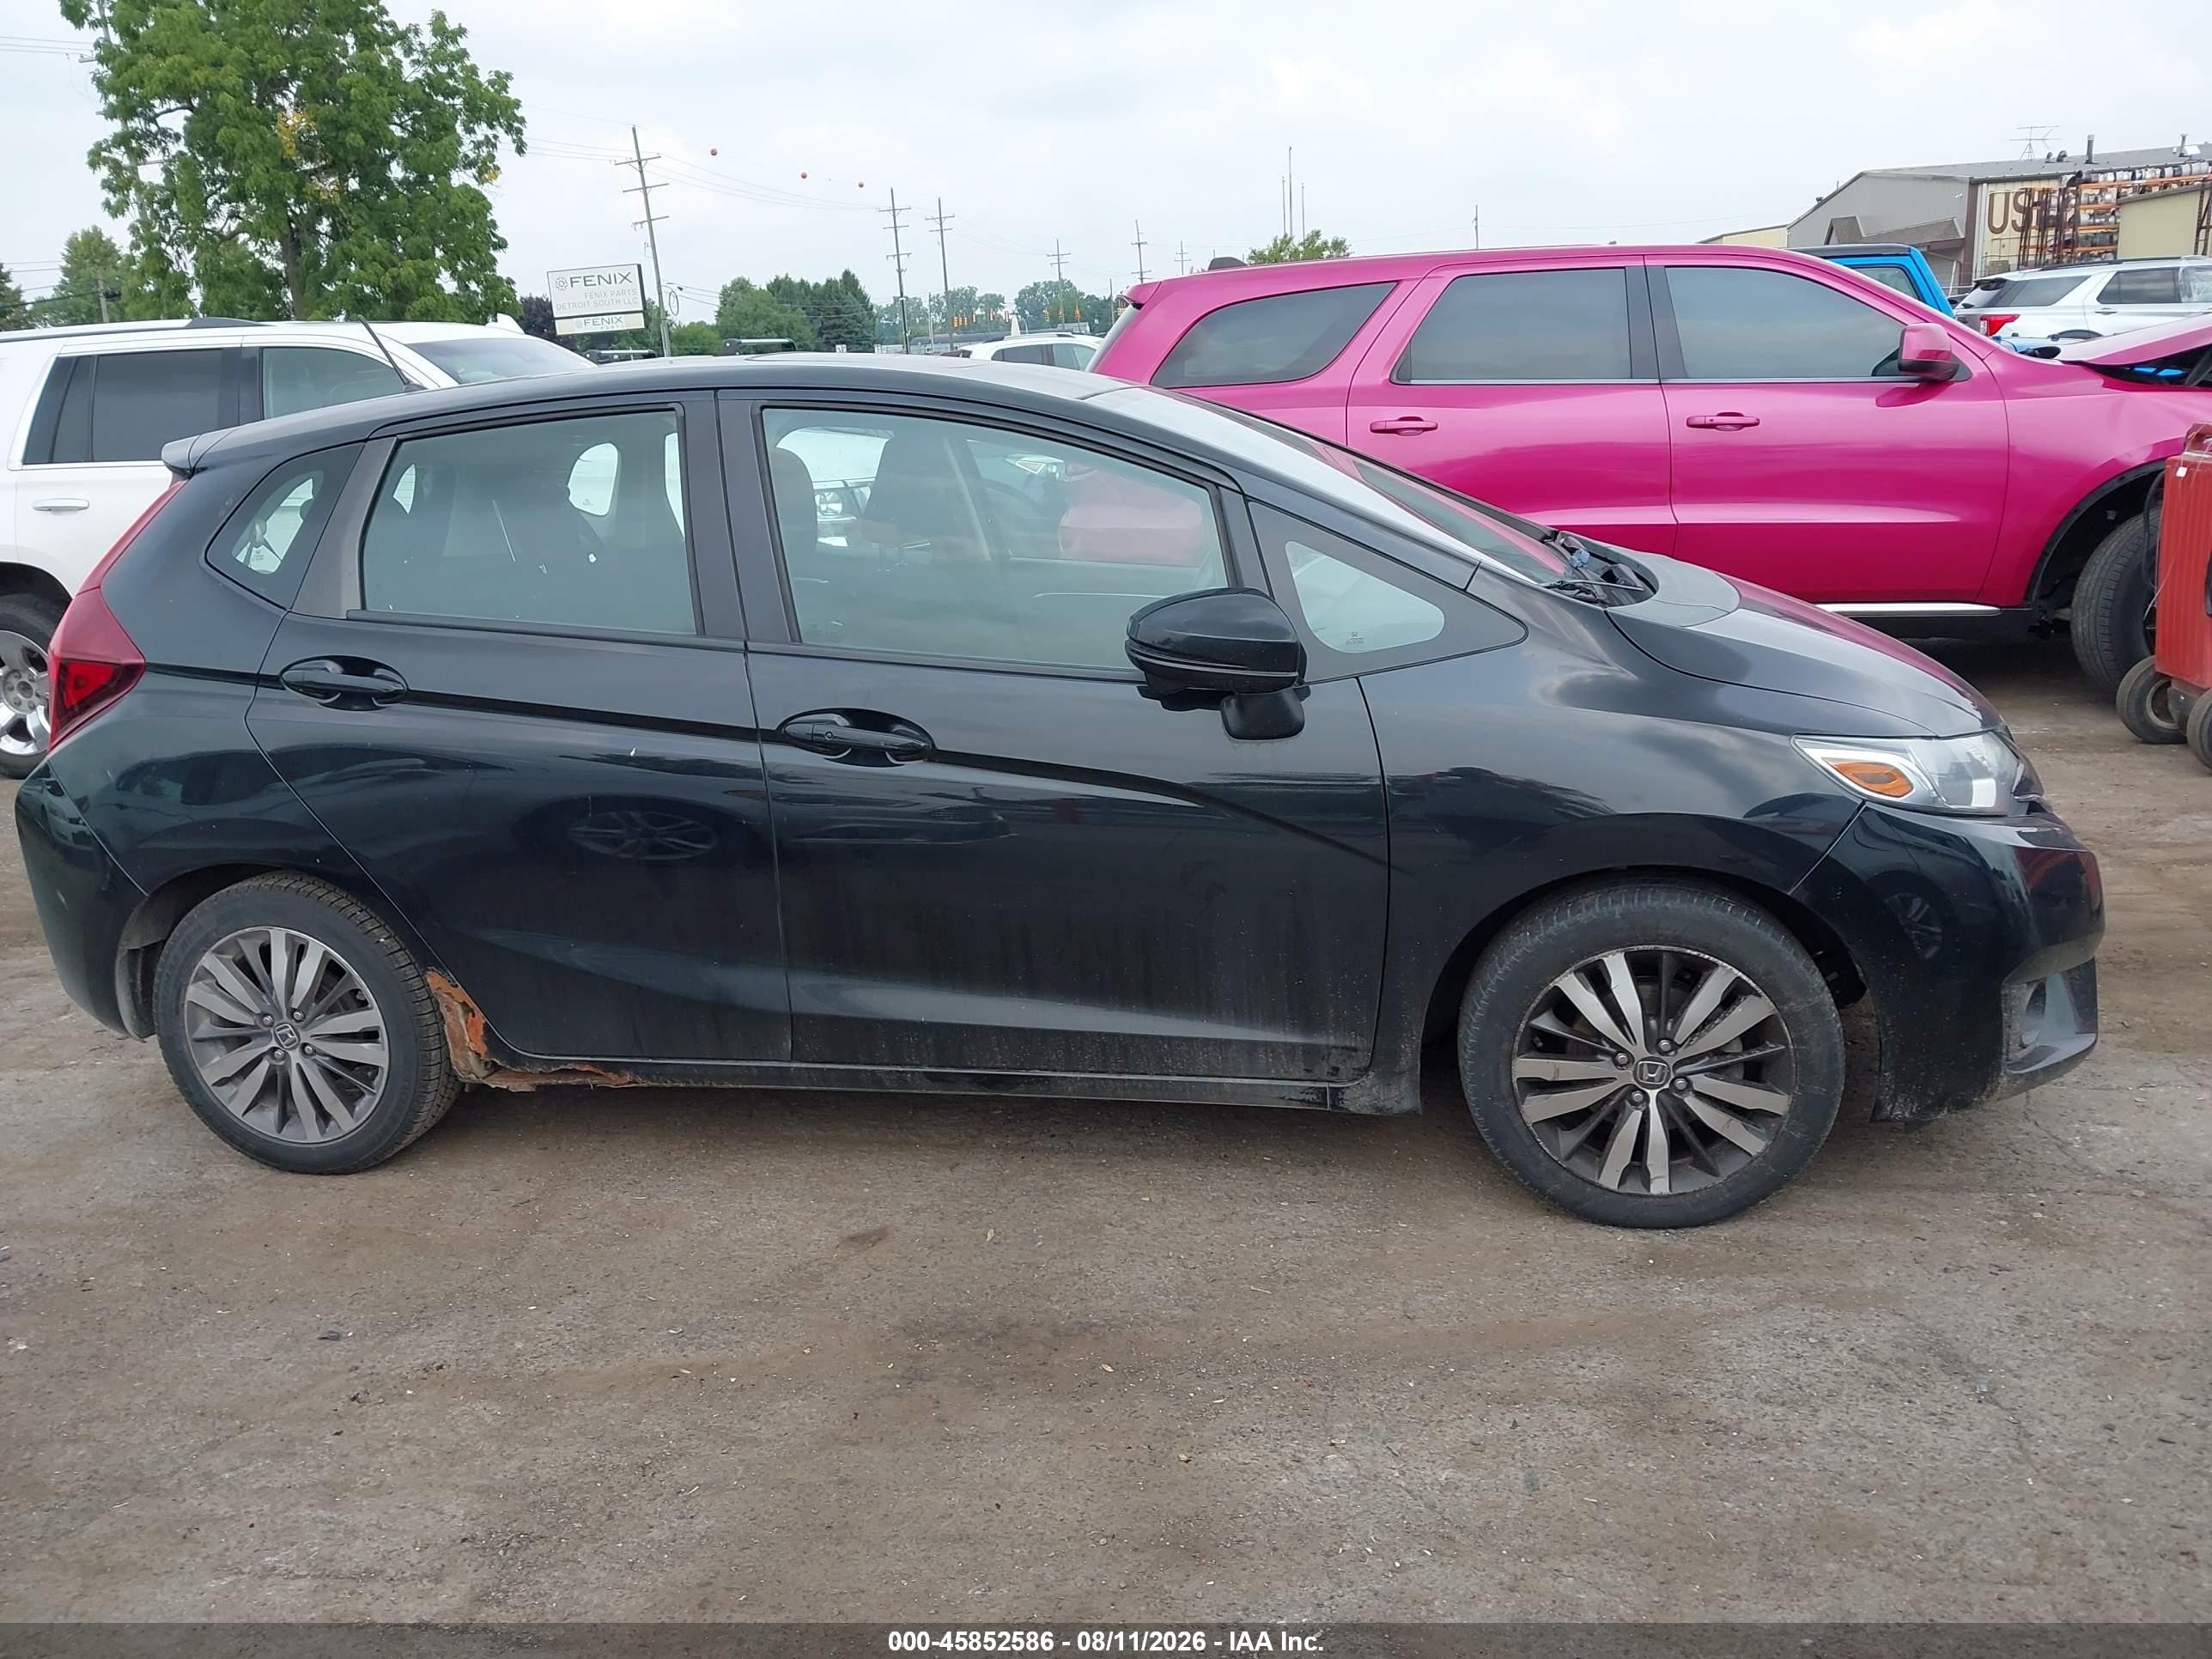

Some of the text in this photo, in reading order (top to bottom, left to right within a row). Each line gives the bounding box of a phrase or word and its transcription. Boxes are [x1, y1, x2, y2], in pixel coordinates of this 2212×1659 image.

[570, 271, 632, 289] FENIX
[585, 289, 638, 300] FENIX PARTS
[556, 301, 591, 310] DETROIT
[592, 299, 621, 307] SOUTH
[584, 316, 623, 327] FENIX
